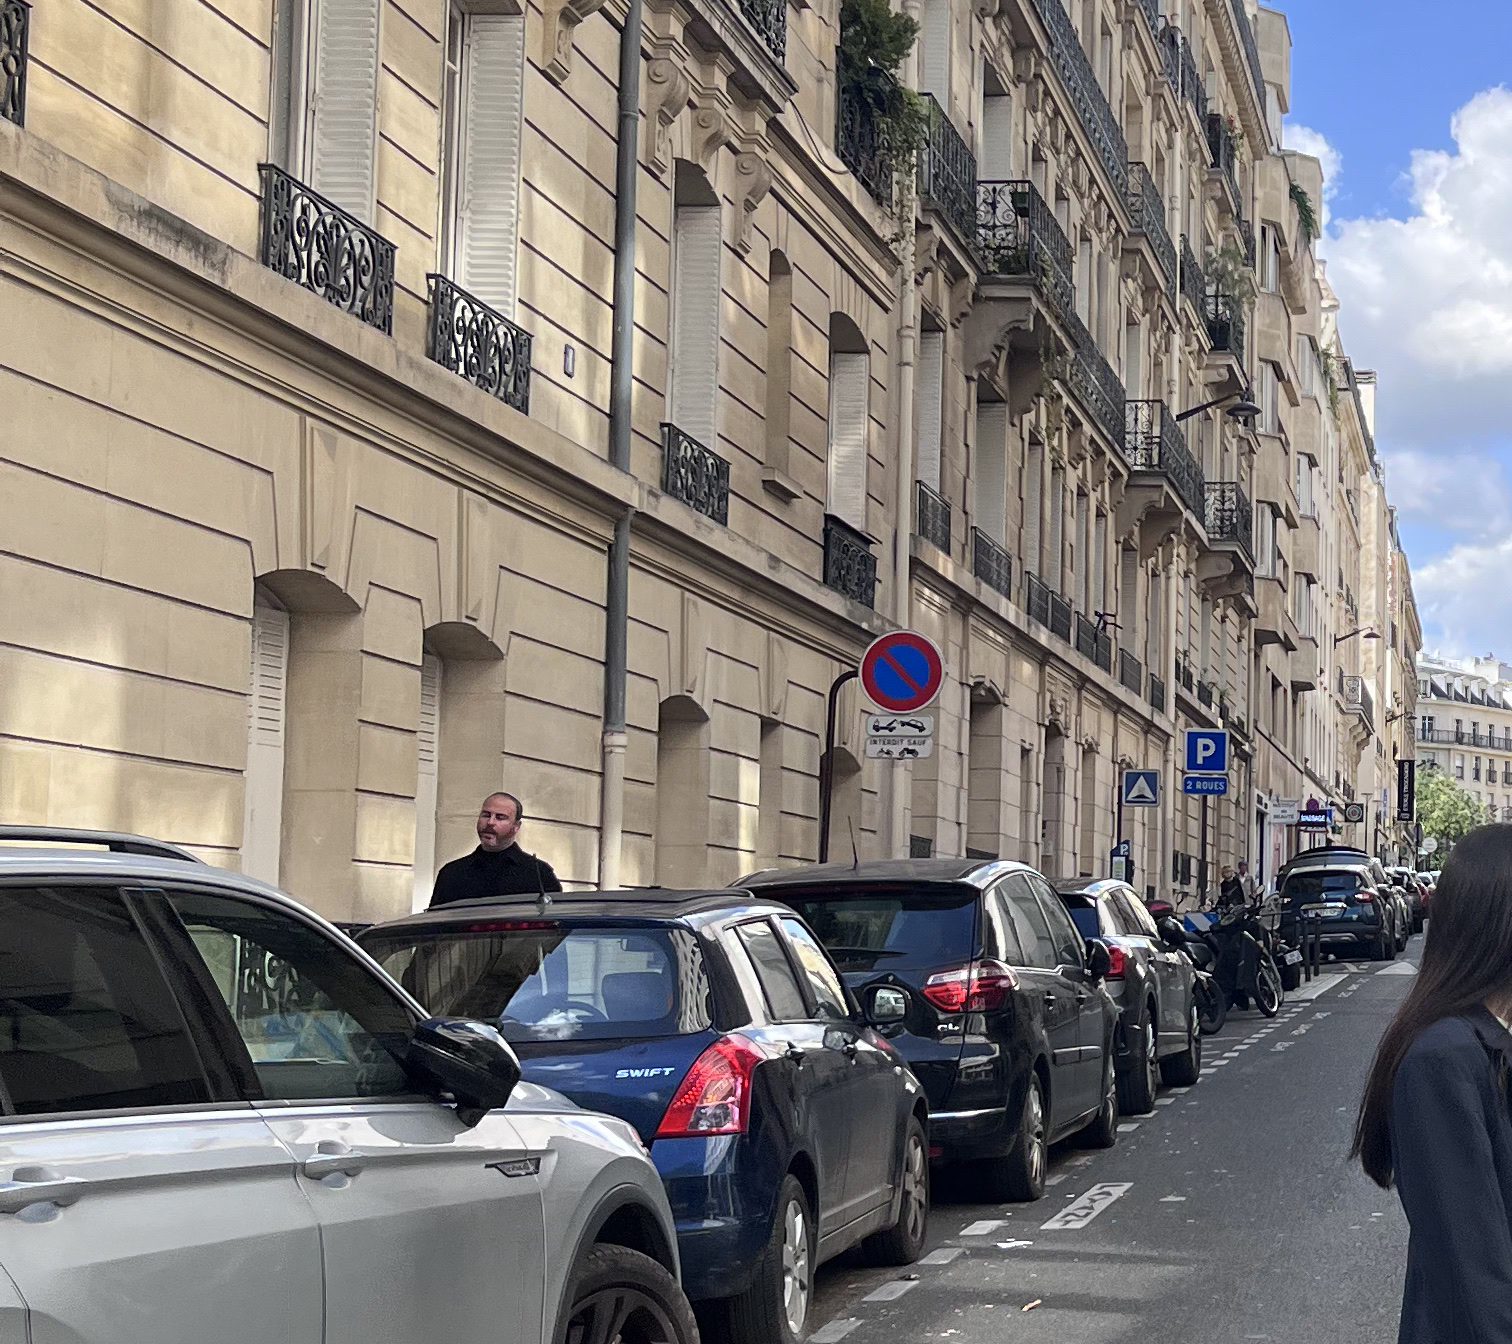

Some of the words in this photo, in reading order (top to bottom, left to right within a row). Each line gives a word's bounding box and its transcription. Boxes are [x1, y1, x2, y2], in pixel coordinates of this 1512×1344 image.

[869, 738, 904, 746] INTERDIT
[907, 738, 927, 746] SAUF
[1196, 737, 1216, 765] P
[1186, 780, 1193, 790] 2
[1195, 780, 1226, 790] ROUES
[615, 1067, 675, 1079] SWIFT
